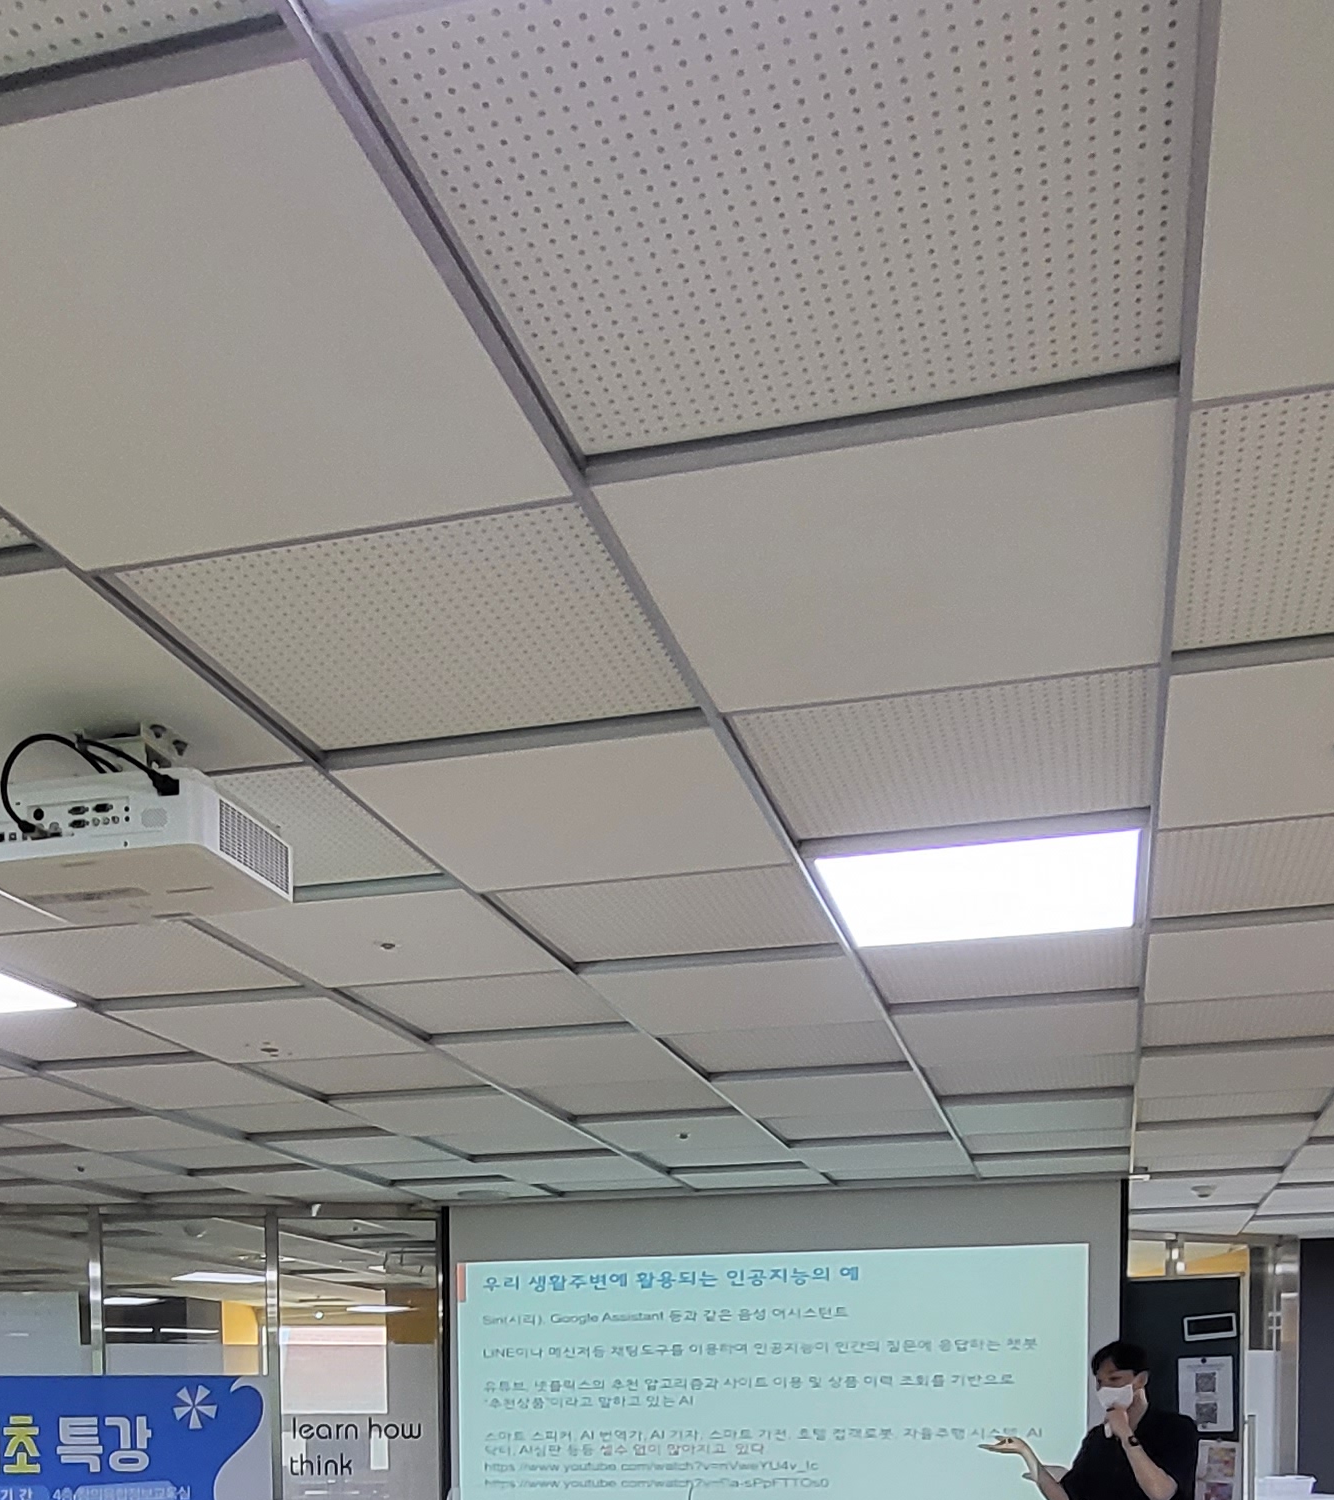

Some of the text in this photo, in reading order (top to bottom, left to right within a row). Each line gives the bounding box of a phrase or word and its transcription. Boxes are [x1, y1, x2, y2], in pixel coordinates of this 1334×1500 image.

[483, 1266, 859, 1293] 우리 생활주변에 활용되는 인공지능의 예
[550, 1313, 599, 1326] Google
[602, 1311, 664, 1322] Assistant
[669, 1309, 697, 1323] 등과
[703, 1309, 732, 1322] 같은
[737, 1308, 766, 1321] 음성
[689, 1342, 748, 1356] 이용하여
[753, 1341, 829, 1355] 인공지능이
[835, 1340, 880, 1354] 인간의
[886, 1340, 932, 1353] 질문에
[939, 1338, 1001, 1352] 응답하는
[723, 1377, 768, 1389] 사이트
[773, 1376, 802, 1389] 이용
[829, 1376, 858, 1389] 상품
[950, 1373, 1015, 1387] 기반으로
[646, 1395, 675, 1408] 있는
[678, 1395, 694, 1407] AI
[292, 1416, 422, 1440] learn how
[484, 1430, 530, 1442] 스마트
[579, 1430, 595, 1441] AI
[650, 1430, 665, 1441] AI
[709, 1429, 754, 1441] 스마트
[1026, 1427, 1043, 1438] AI
[56, 1415, 153, 1473] 특강
[633, 1443, 661, 1457] 없이
[736, 1442, 765, 1456] 있다
[290, 1453, 353, 1476] think
